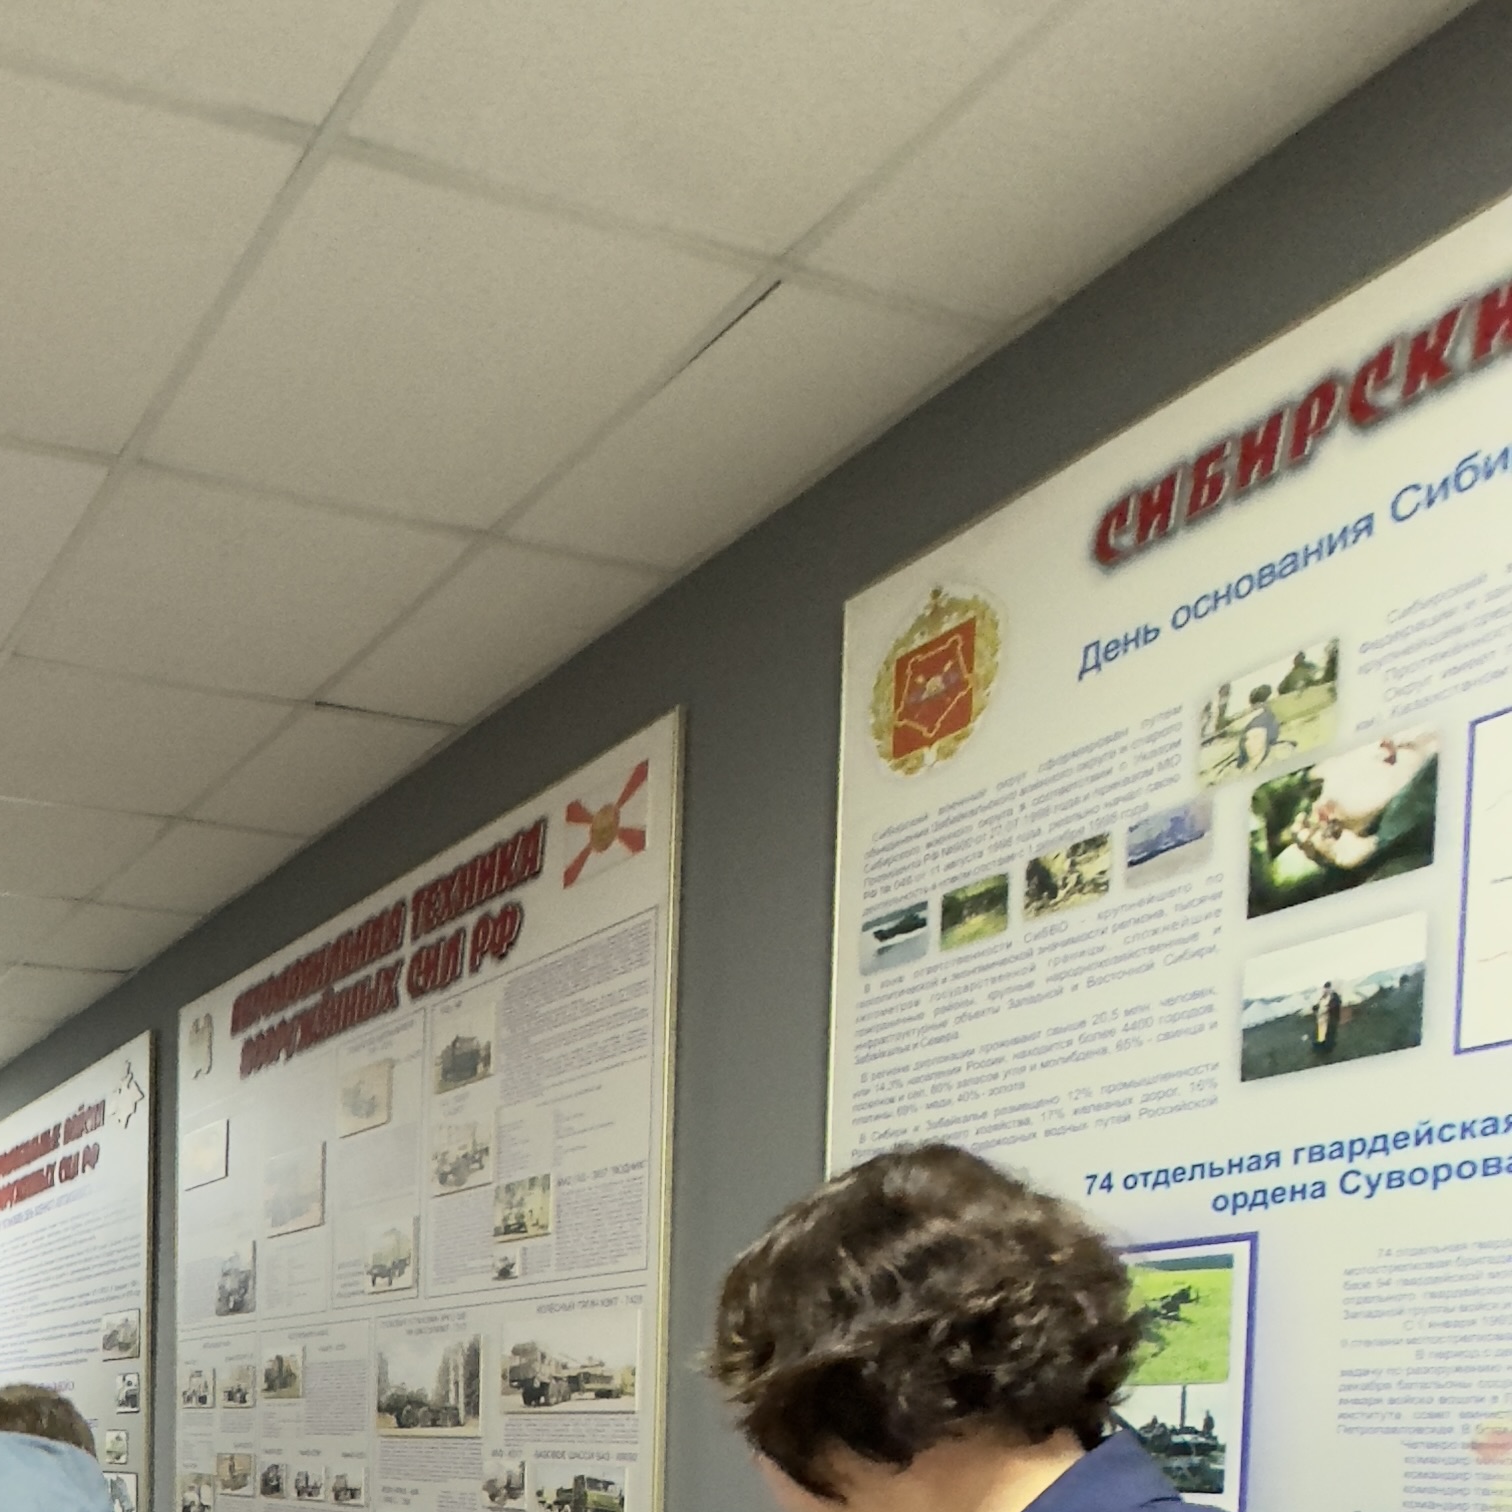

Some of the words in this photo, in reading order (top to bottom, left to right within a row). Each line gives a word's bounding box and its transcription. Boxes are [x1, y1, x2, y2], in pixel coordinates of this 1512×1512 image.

[1078, 624, 1161, 681] День
[1171, 510, 1375, 631] основания
[1391, 445, 1510, 522] Сиби
[406, 926, 466, 999] СИЛ
[468, 901, 525, 977] РФ
[1085, 1173, 1115, 1196] 74
[1123, 1150, 1281, 1190] отдельная
[1293, 1114, 1512, 1166] гвардейская
[1212, 1178, 1327, 1215] ордена
